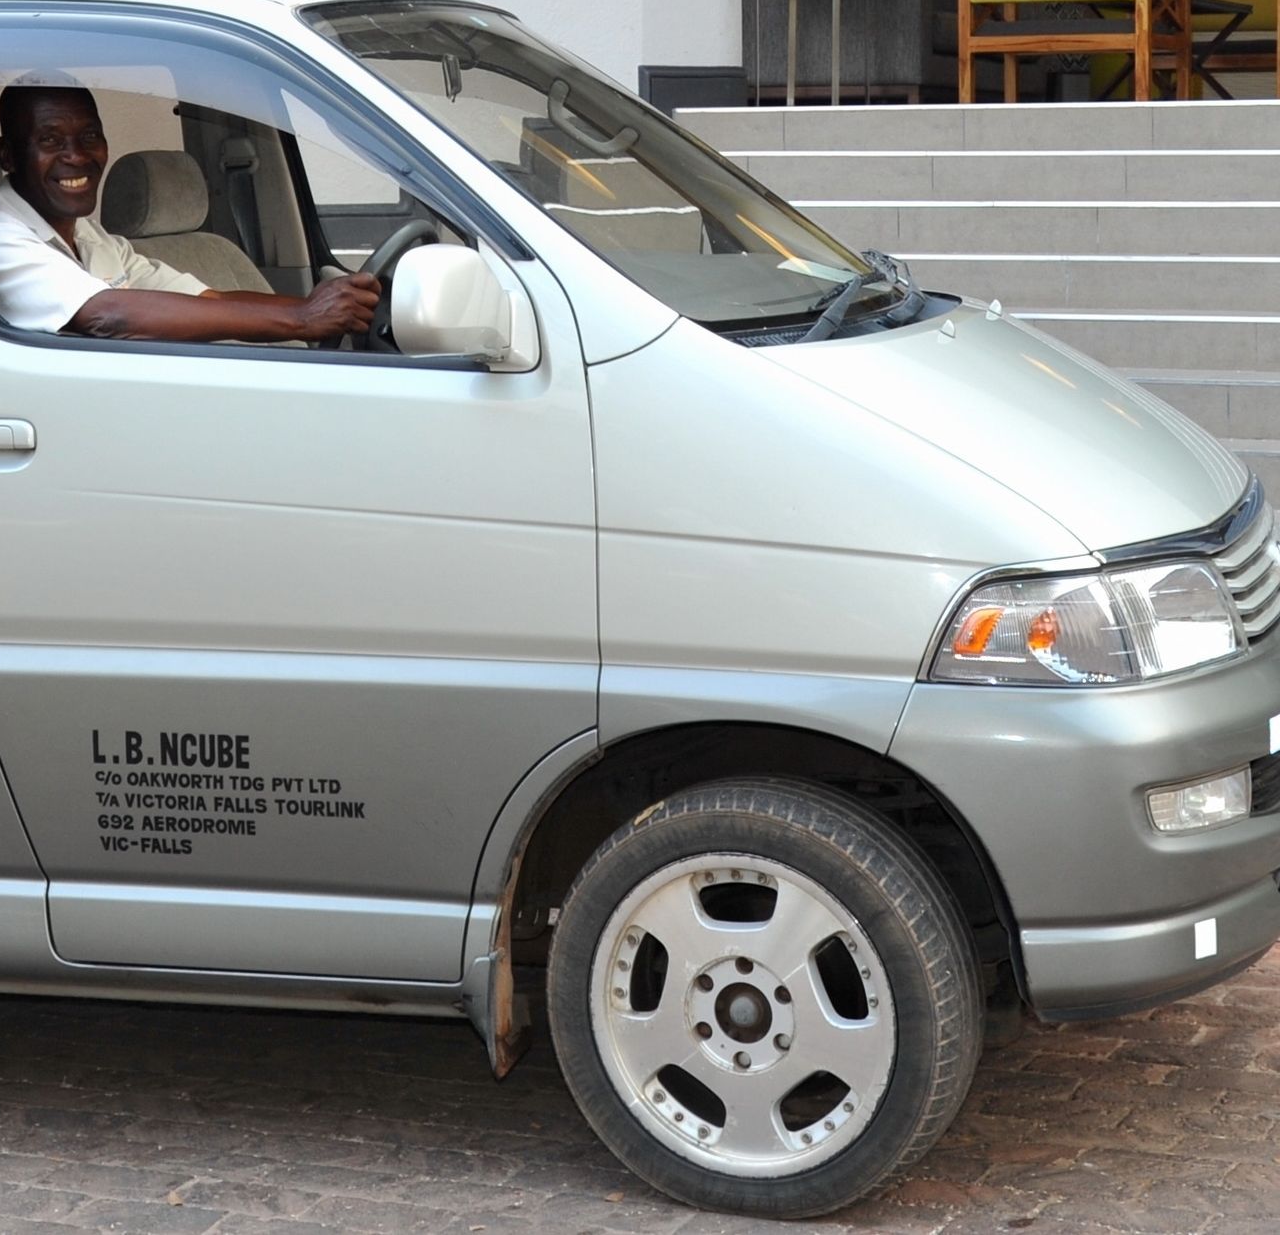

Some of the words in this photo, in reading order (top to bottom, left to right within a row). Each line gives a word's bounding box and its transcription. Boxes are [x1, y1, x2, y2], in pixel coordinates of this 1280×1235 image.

[127, 772, 224, 790] OAKWORTH
[230, 776, 264, 791] TDG
[272, 778, 304, 792] PVT
[310, 779, 341, 794] LTD
[96, 792, 119, 807] T/A
[125, 794, 207, 812] VICTORIA
[214, 797, 267, 814] FALLS
[275, 799, 366, 818] TOURLINK
[98, 815, 134, 830] 692
[142, 817, 256, 835] AERODROME
[100, 836, 192, 854] VIC-FALLS
